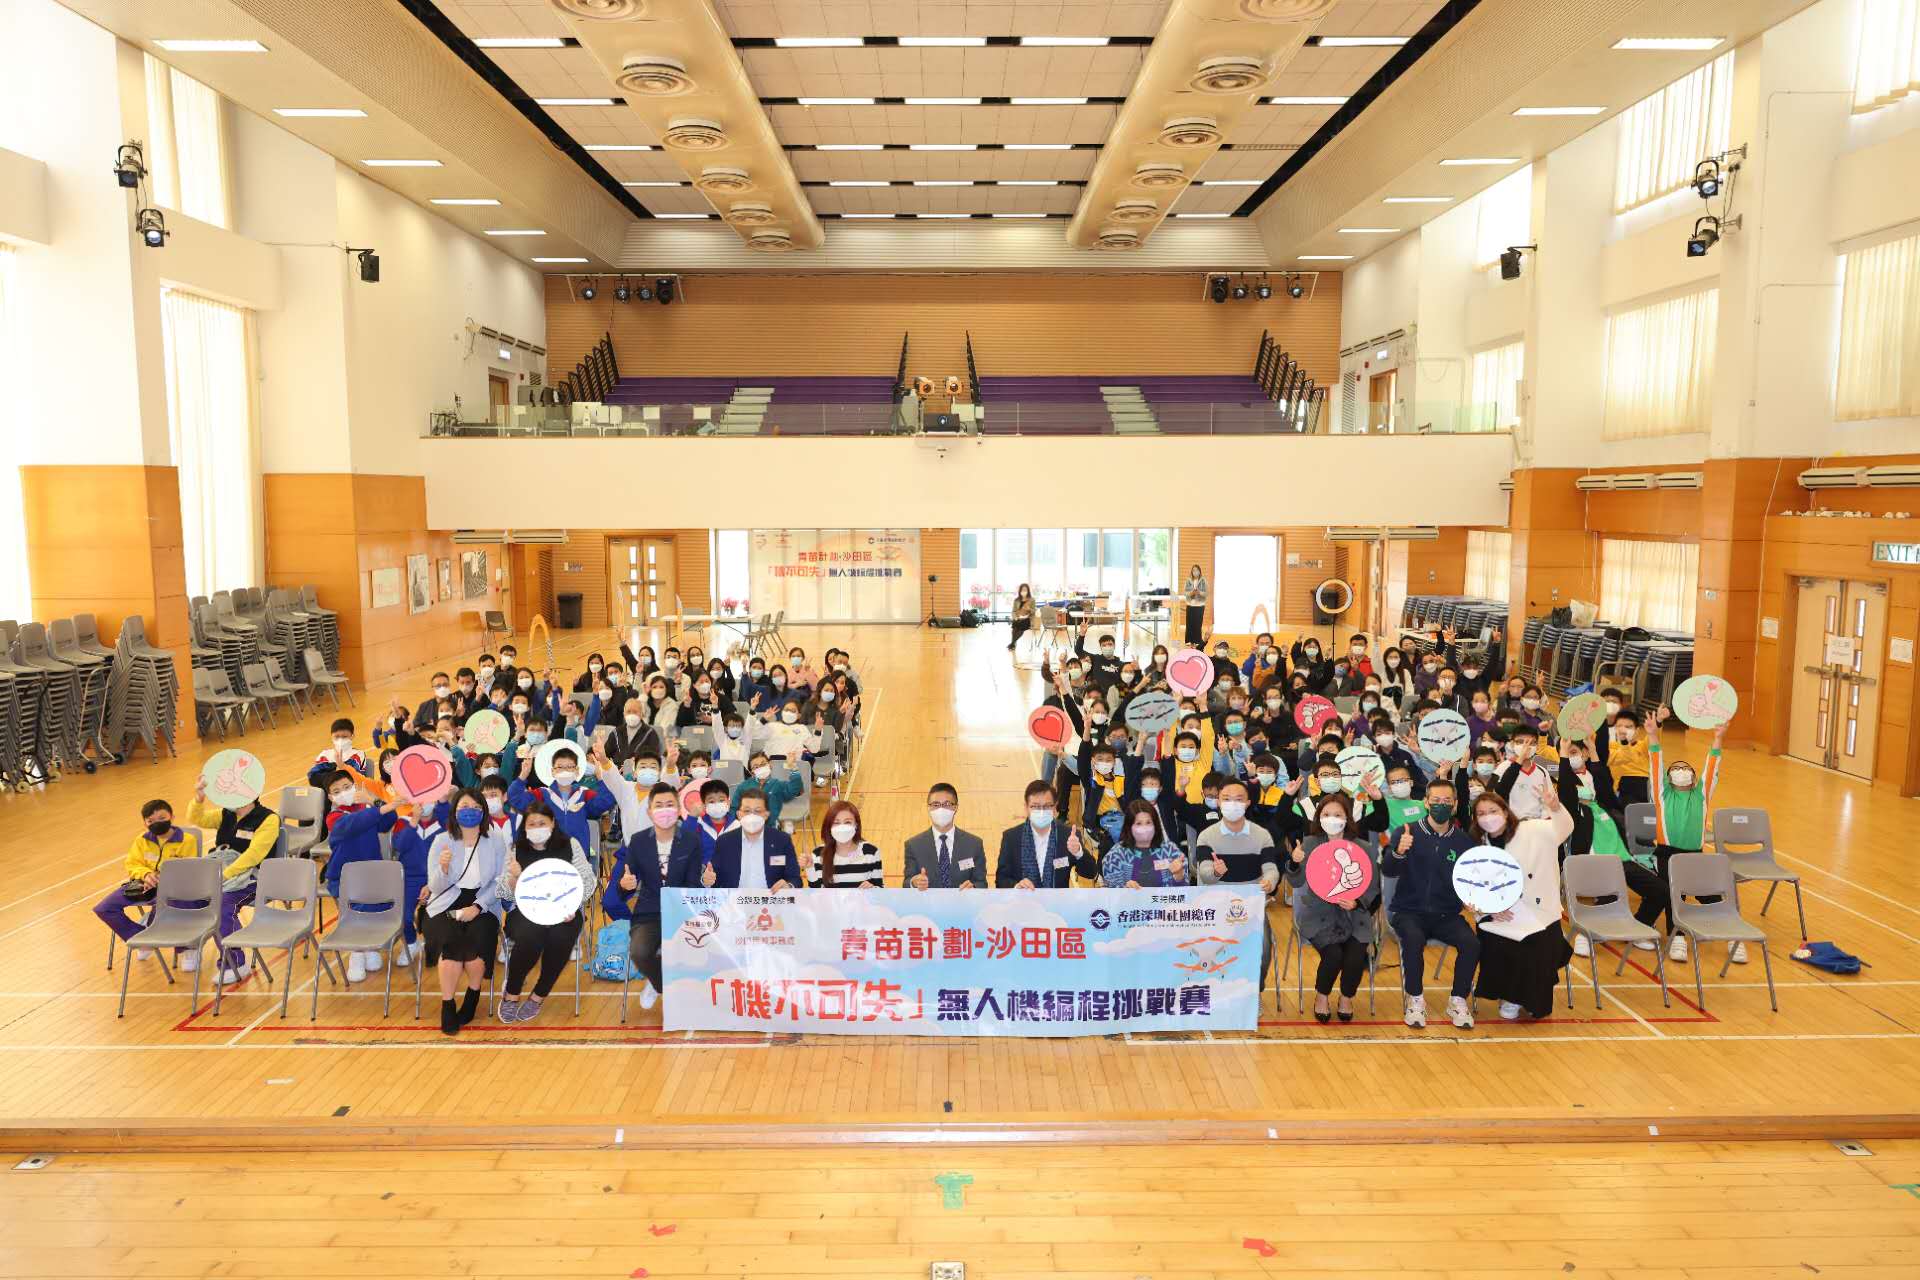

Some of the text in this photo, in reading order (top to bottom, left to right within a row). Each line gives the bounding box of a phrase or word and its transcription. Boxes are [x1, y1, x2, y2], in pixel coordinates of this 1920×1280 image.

[1876, 543, 1912, 561] EXIT
[1151, 894, 1186, 904] 支持機構
[1117, 908, 1216, 923] 香港深圳社團總會
